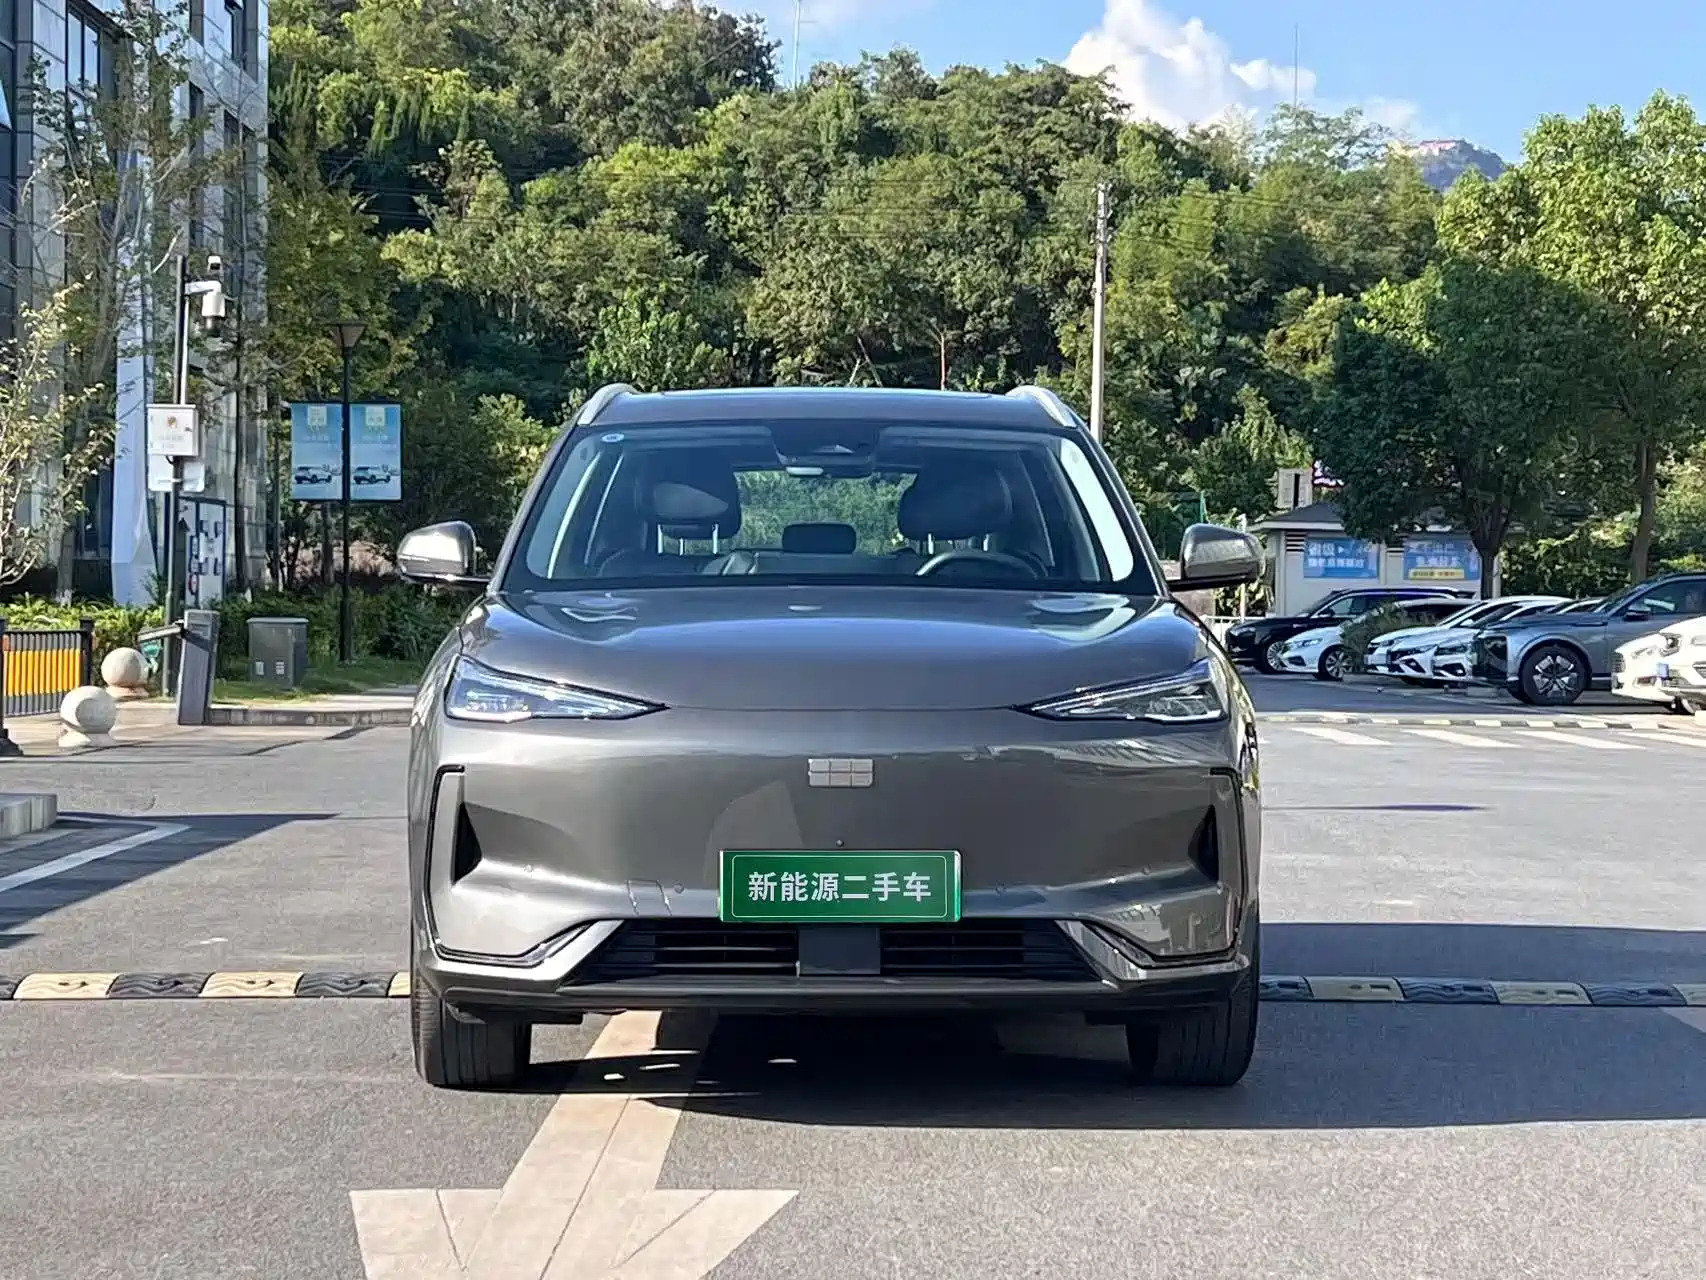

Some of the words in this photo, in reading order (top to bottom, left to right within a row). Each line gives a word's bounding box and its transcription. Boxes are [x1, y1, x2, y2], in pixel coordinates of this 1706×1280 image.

[748, 871, 932, 902] 新能源二手车
